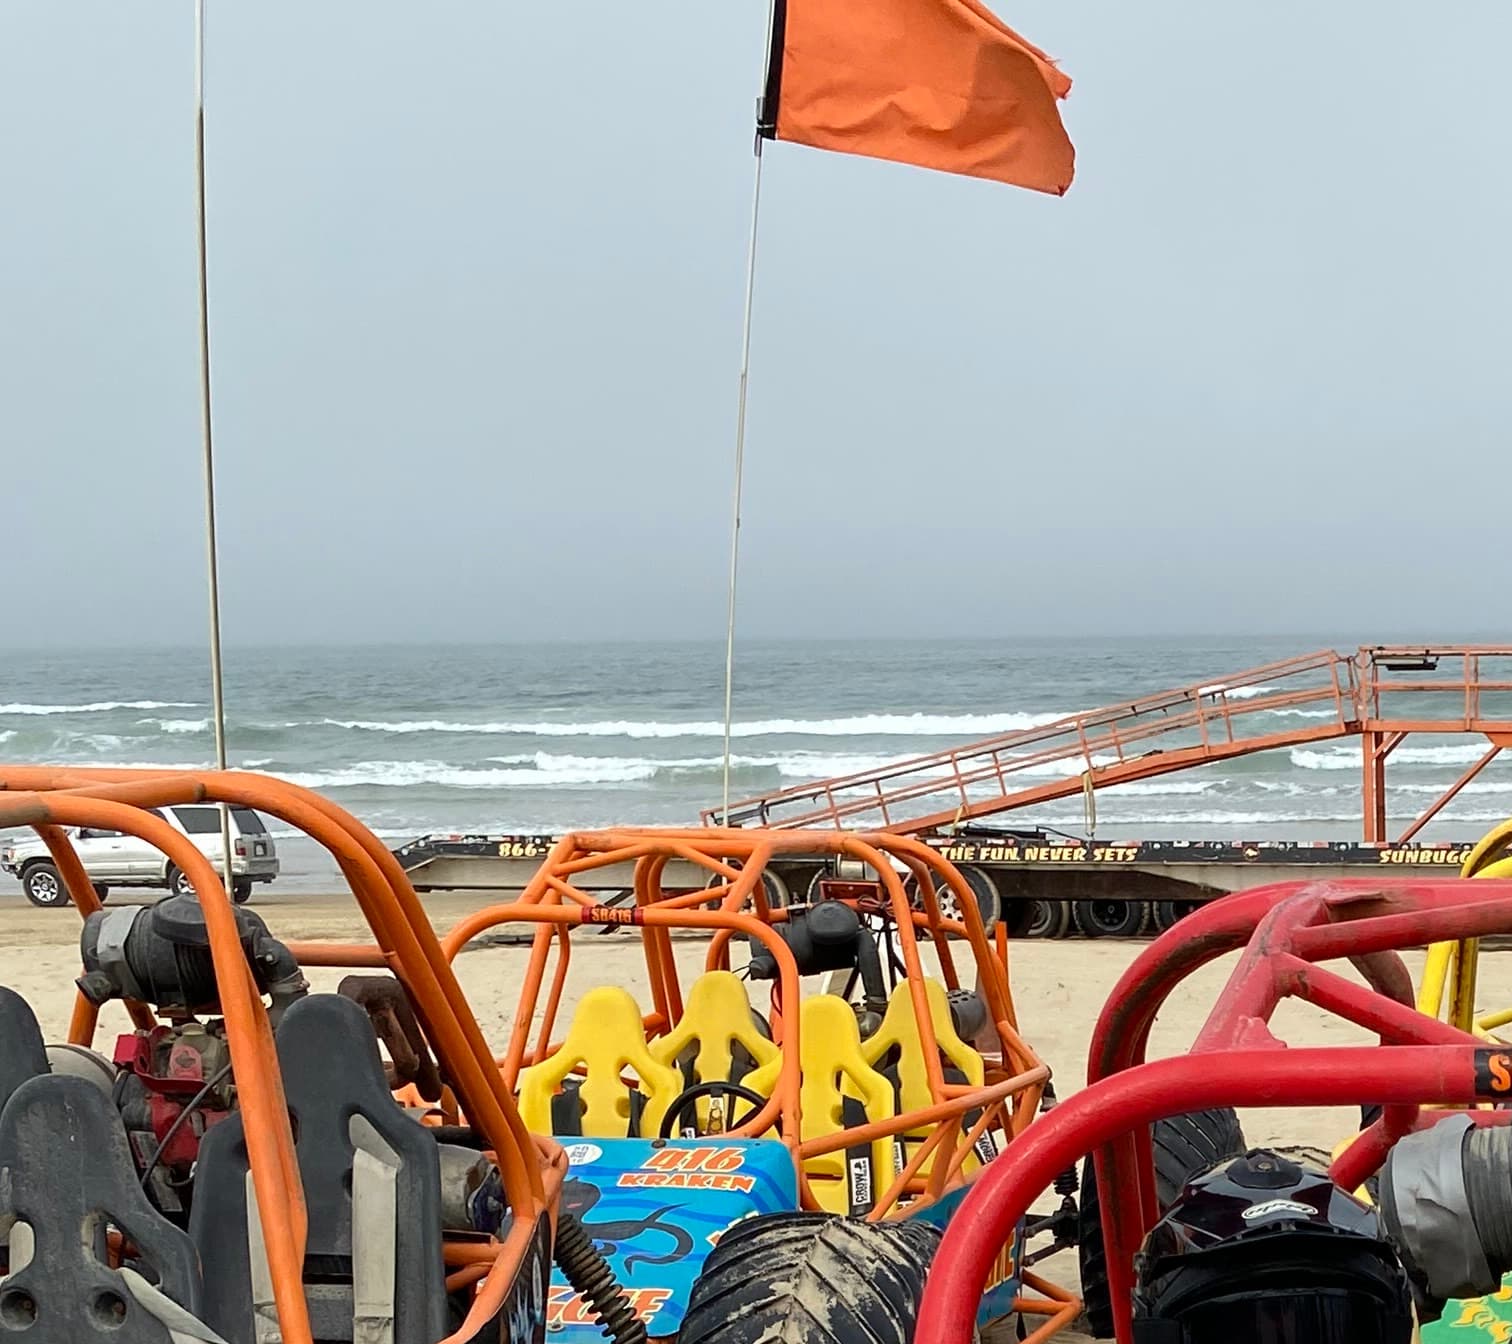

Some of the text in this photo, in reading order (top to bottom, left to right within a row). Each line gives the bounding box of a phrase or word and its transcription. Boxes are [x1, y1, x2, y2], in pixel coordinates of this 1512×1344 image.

[940, 847, 974, 861] THE
[1025, 847, 1086, 861] NEVER
[1093, 847, 1137, 861] SETS
[640, 1148, 747, 1172] 416
[617, 1173, 755, 1193] KRAKEN
